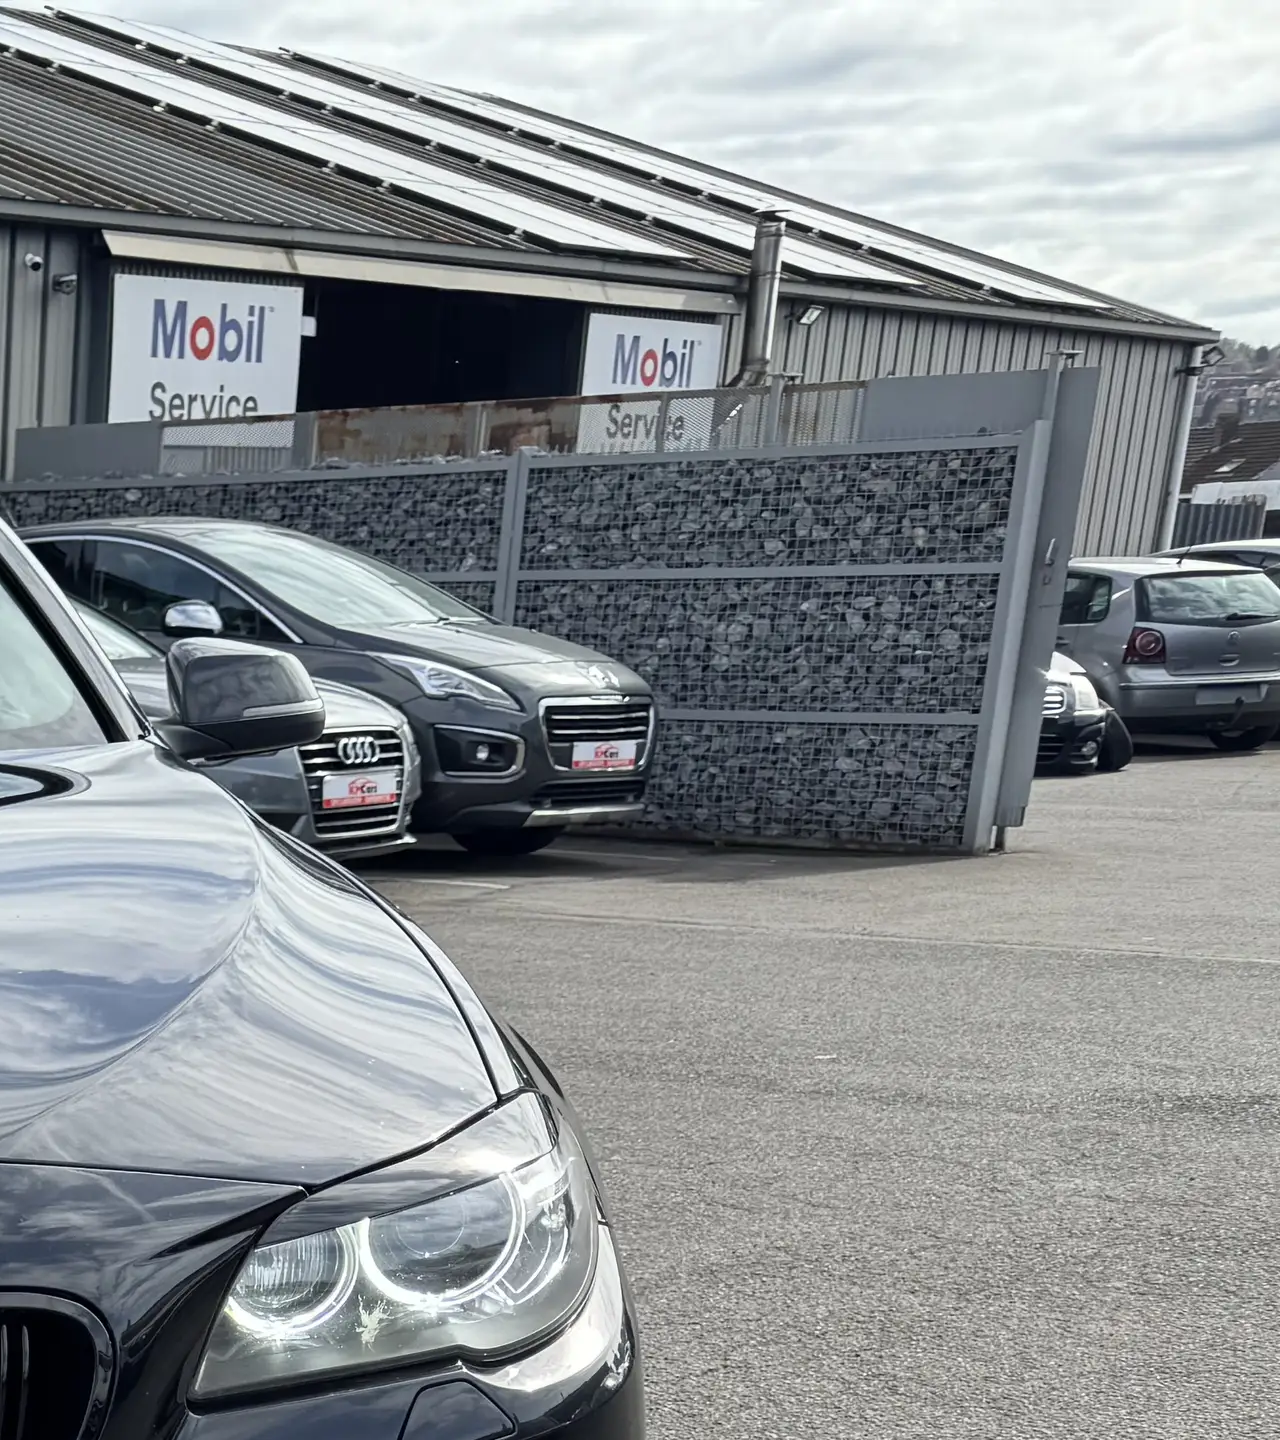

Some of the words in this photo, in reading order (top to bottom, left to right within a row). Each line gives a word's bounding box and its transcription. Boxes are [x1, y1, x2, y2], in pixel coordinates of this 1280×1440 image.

[150, 298, 266, 364] Mobil
[612, 333, 695, 388] Mobil
[148, 381, 258, 420] Service
[606, 403, 685, 441] Serve
